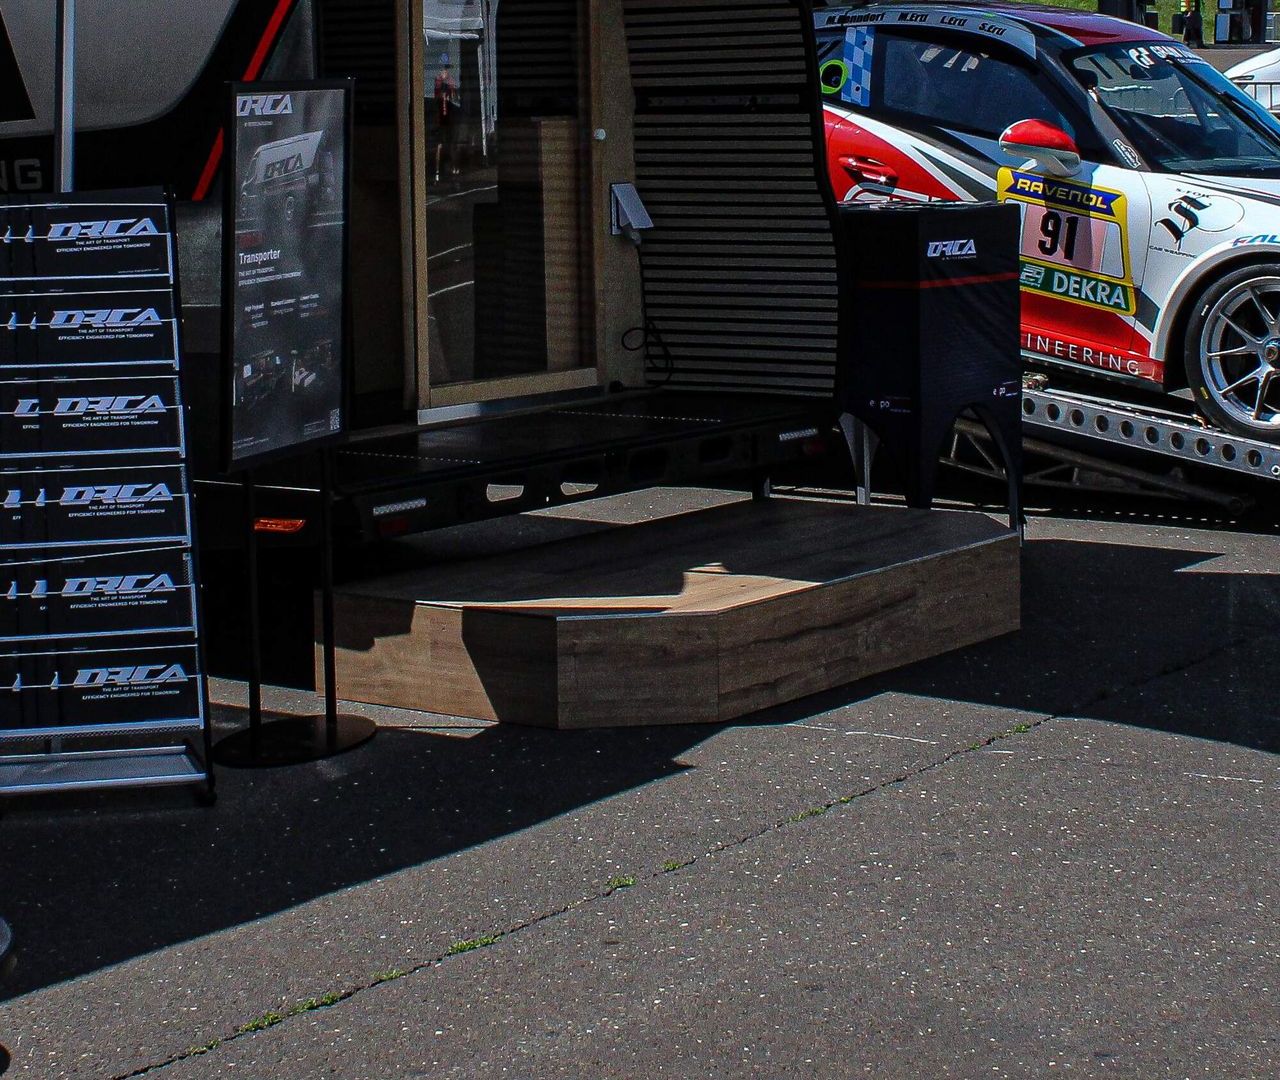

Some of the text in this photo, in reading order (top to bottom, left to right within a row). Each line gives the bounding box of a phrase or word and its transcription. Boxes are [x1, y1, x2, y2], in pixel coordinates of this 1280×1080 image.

[236, 94, 293, 116] ORCA
[1016, 178, 1108, 209] RAVENOL
[927, 239, 977, 258] ORCA
[1038, 210, 1079, 261] 91
[239, 249, 281, 265] Transporter
[1052, 271, 1127, 309] DEKRA
